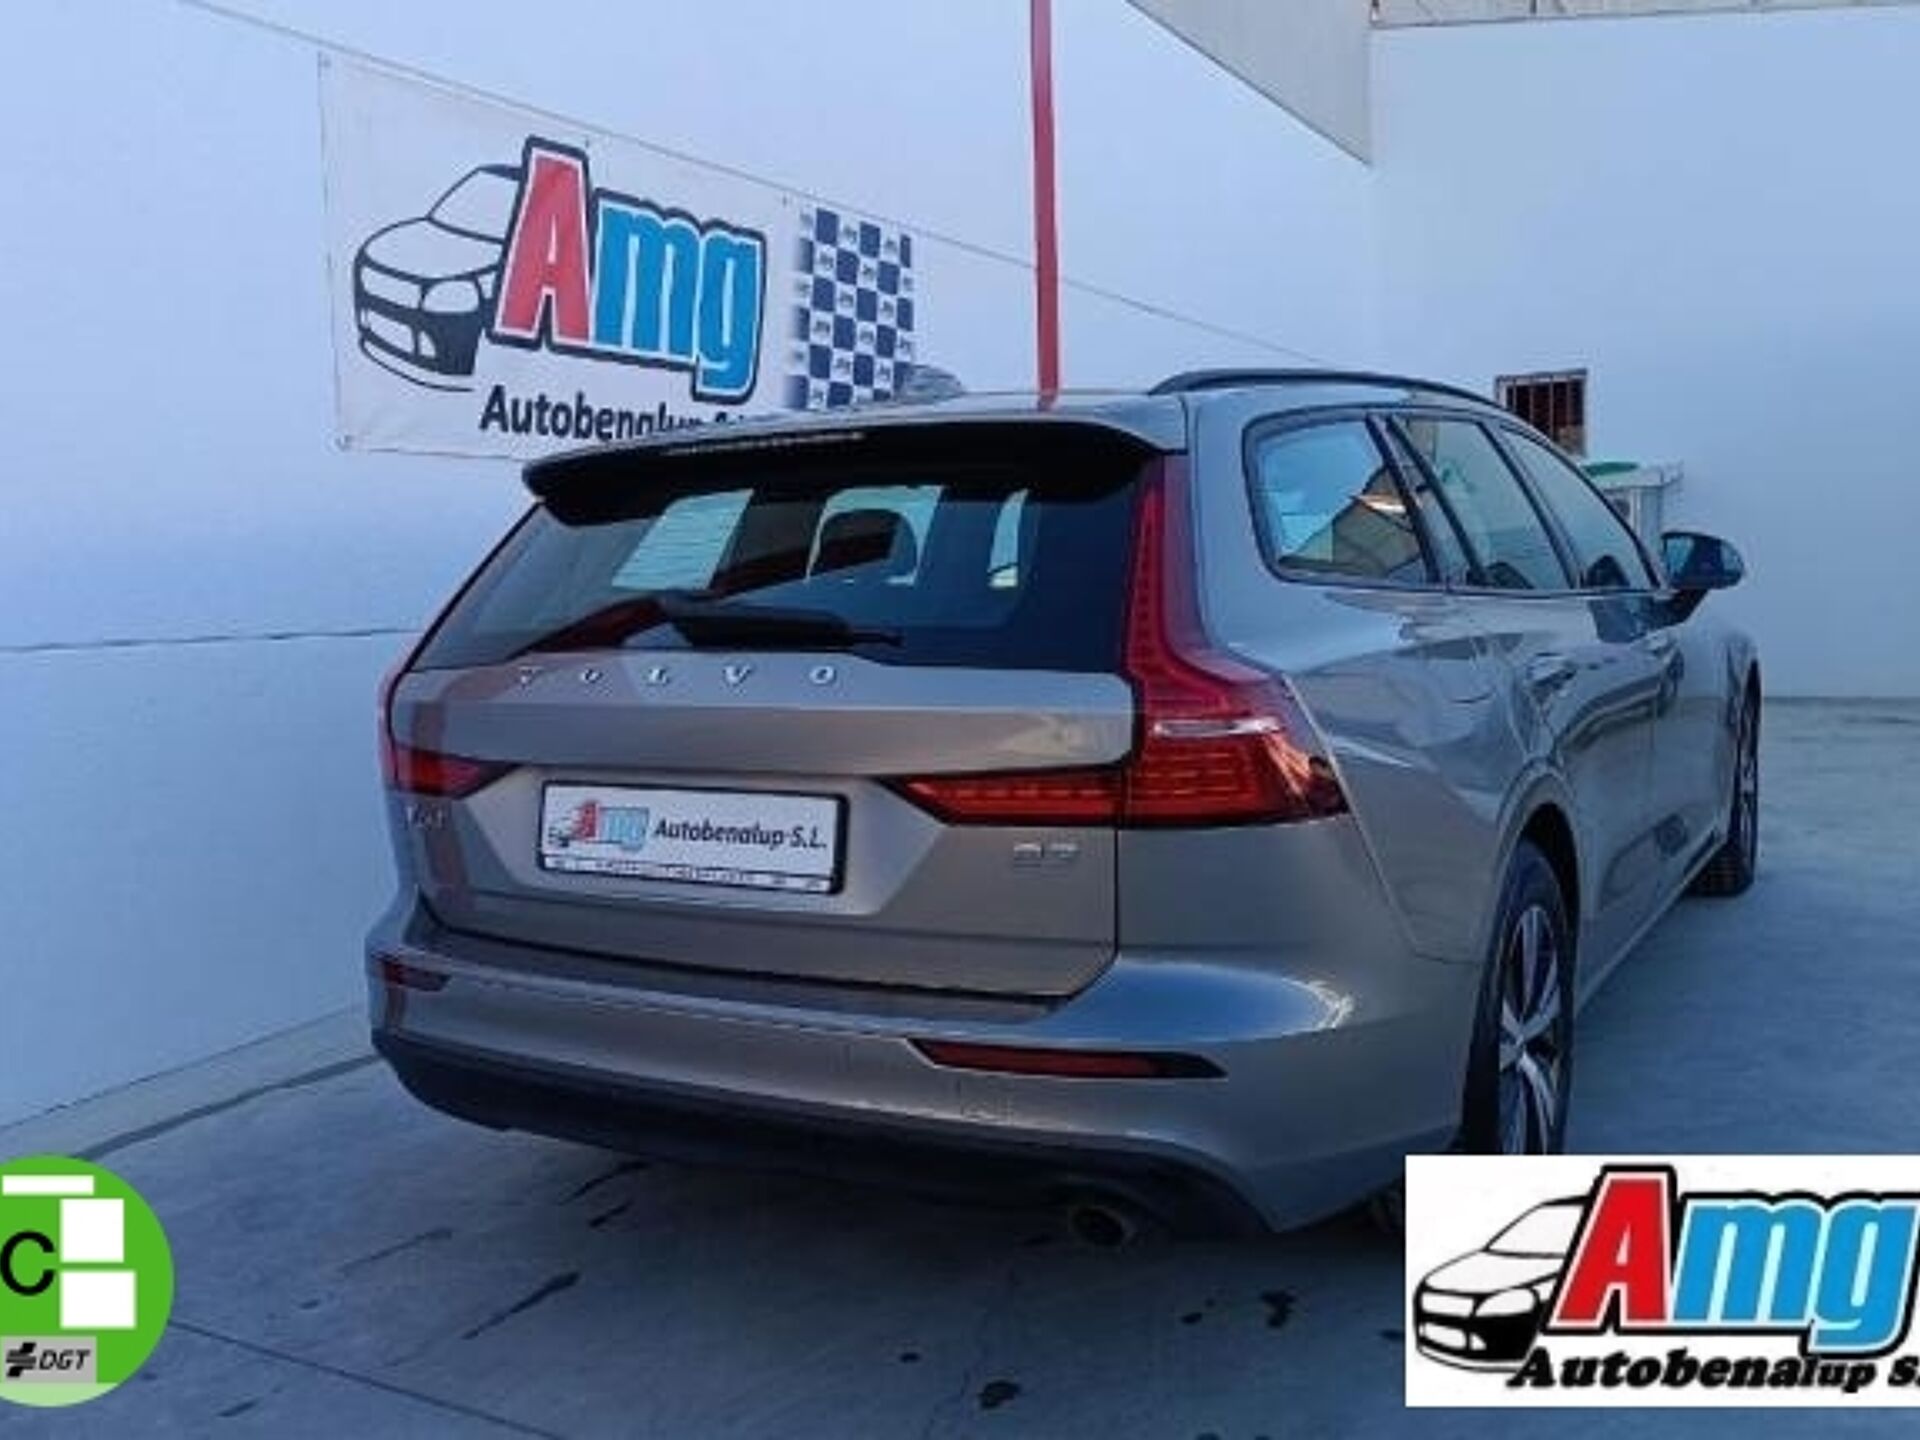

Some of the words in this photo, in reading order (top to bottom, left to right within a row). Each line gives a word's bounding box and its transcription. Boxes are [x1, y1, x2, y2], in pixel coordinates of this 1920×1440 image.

[484, 135, 767, 405] Amg
[518, 664, 838, 686] VOLVO
[654, 817, 785, 851] Autobenalup
[789, 825, 829, 849] S.L.
